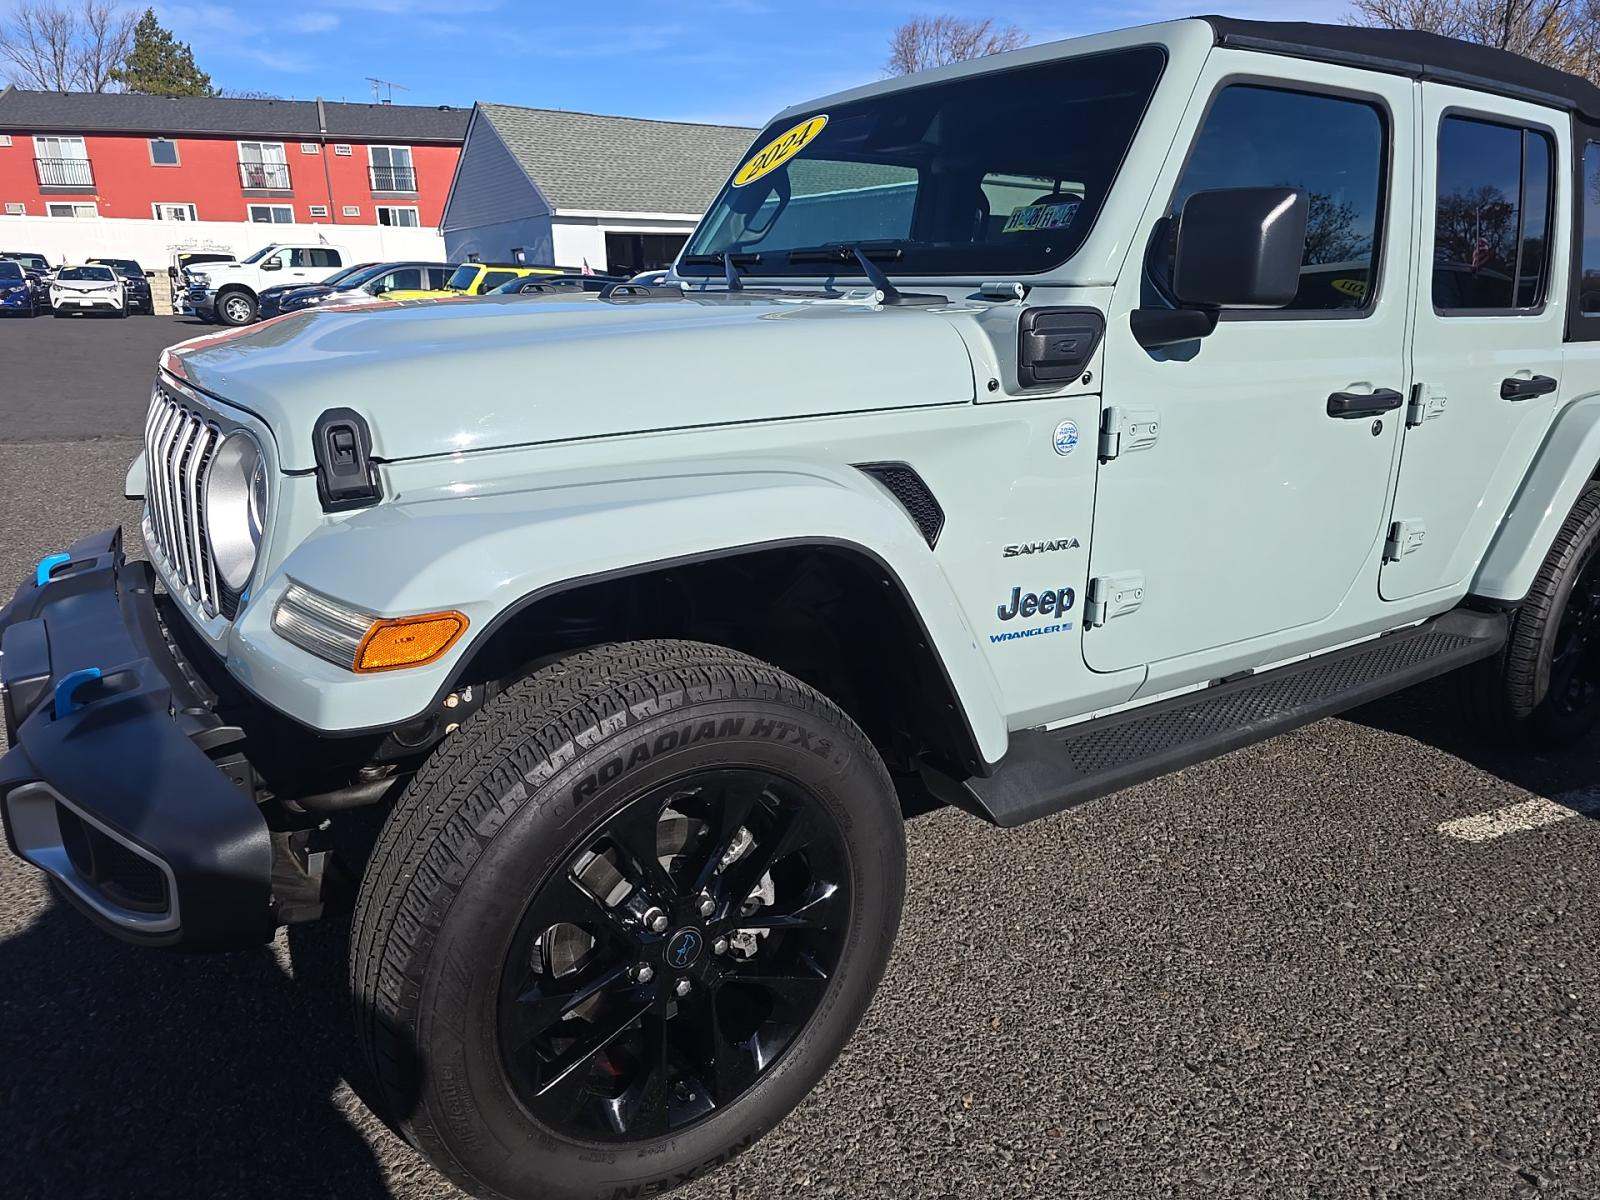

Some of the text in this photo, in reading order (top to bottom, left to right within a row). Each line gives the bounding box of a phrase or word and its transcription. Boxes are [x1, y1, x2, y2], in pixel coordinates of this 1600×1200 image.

[744, 120, 815, 181] 2024
[1002, 538, 1080, 558] SAHARA
[997, 586, 1076, 621] Jeep
[989, 624, 1061, 643] WRANGLER
[572, 716, 746, 808] ROADIAN
